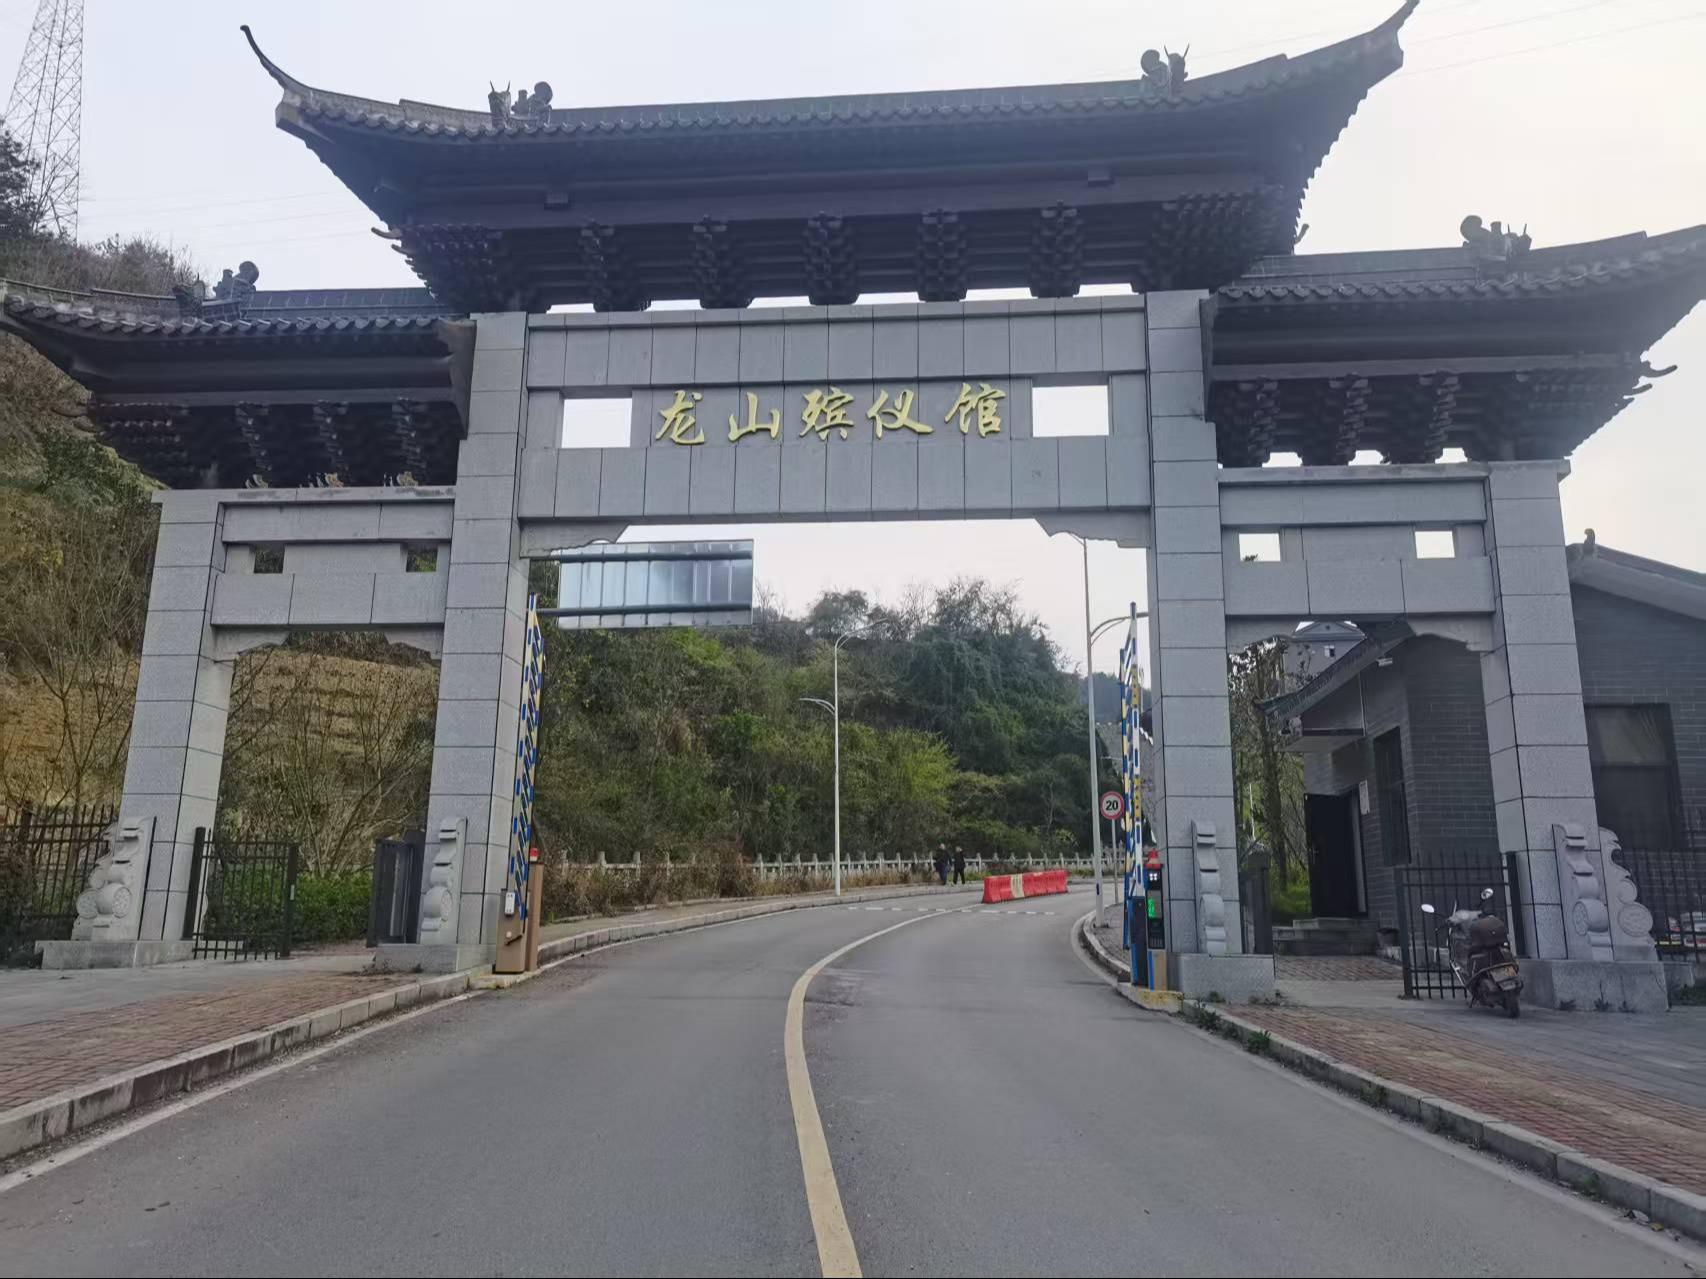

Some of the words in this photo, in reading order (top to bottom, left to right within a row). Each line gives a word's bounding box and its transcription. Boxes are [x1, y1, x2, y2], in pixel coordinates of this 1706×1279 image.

[655, 382, 1006, 445] 龙山殡仪馆
[1105, 800, 1119, 811] 20
